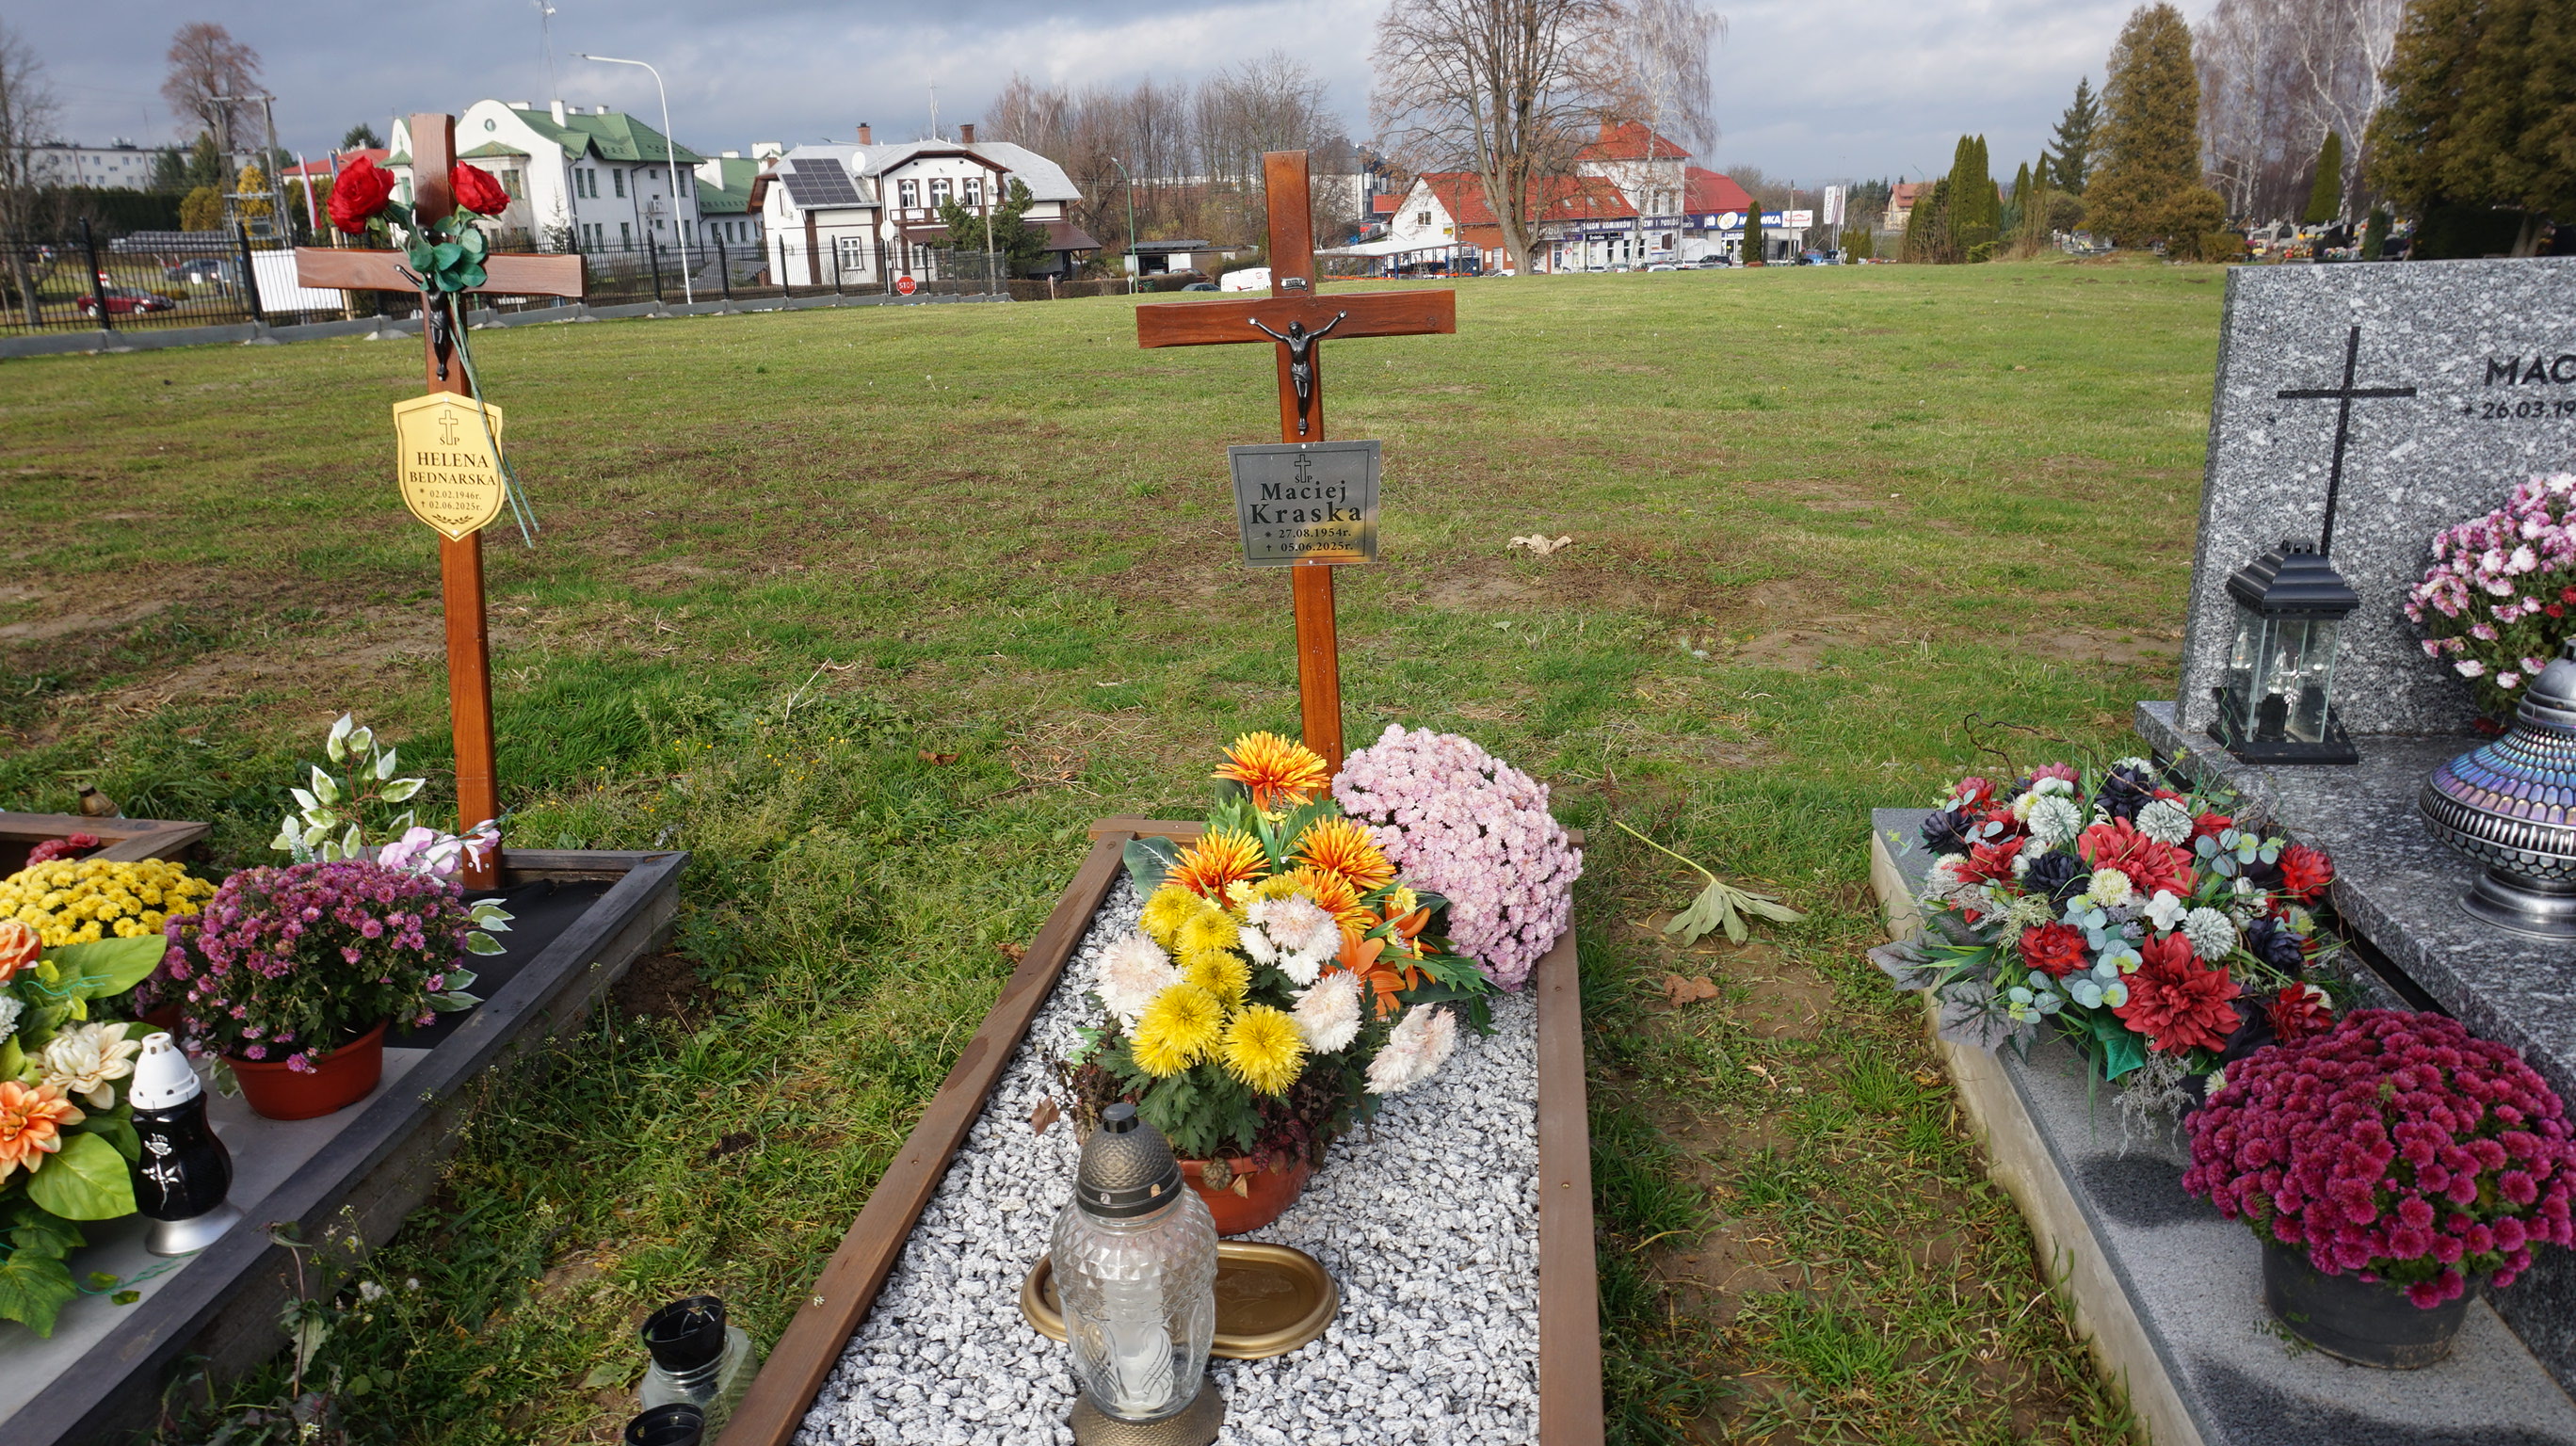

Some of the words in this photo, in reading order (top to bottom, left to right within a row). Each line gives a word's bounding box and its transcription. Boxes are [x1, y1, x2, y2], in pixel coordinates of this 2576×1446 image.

[1738, 214, 1781, 225] MWKA
[417, 452, 490, 468] HELENA
[410, 472, 496, 486] BEDNARSKA
[429, 490, 482, 500] 02.02.1946r.
[1260, 479, 1346, 503] Maciej
[428, 501, 483, 511] 02.06.2025r.
[1249, 501, 1361, 524] Kraska
[1279, 527, 1351, 538] 27.08.1954r.
[1280, 541, 1353, 552] 05.06.2025r.
